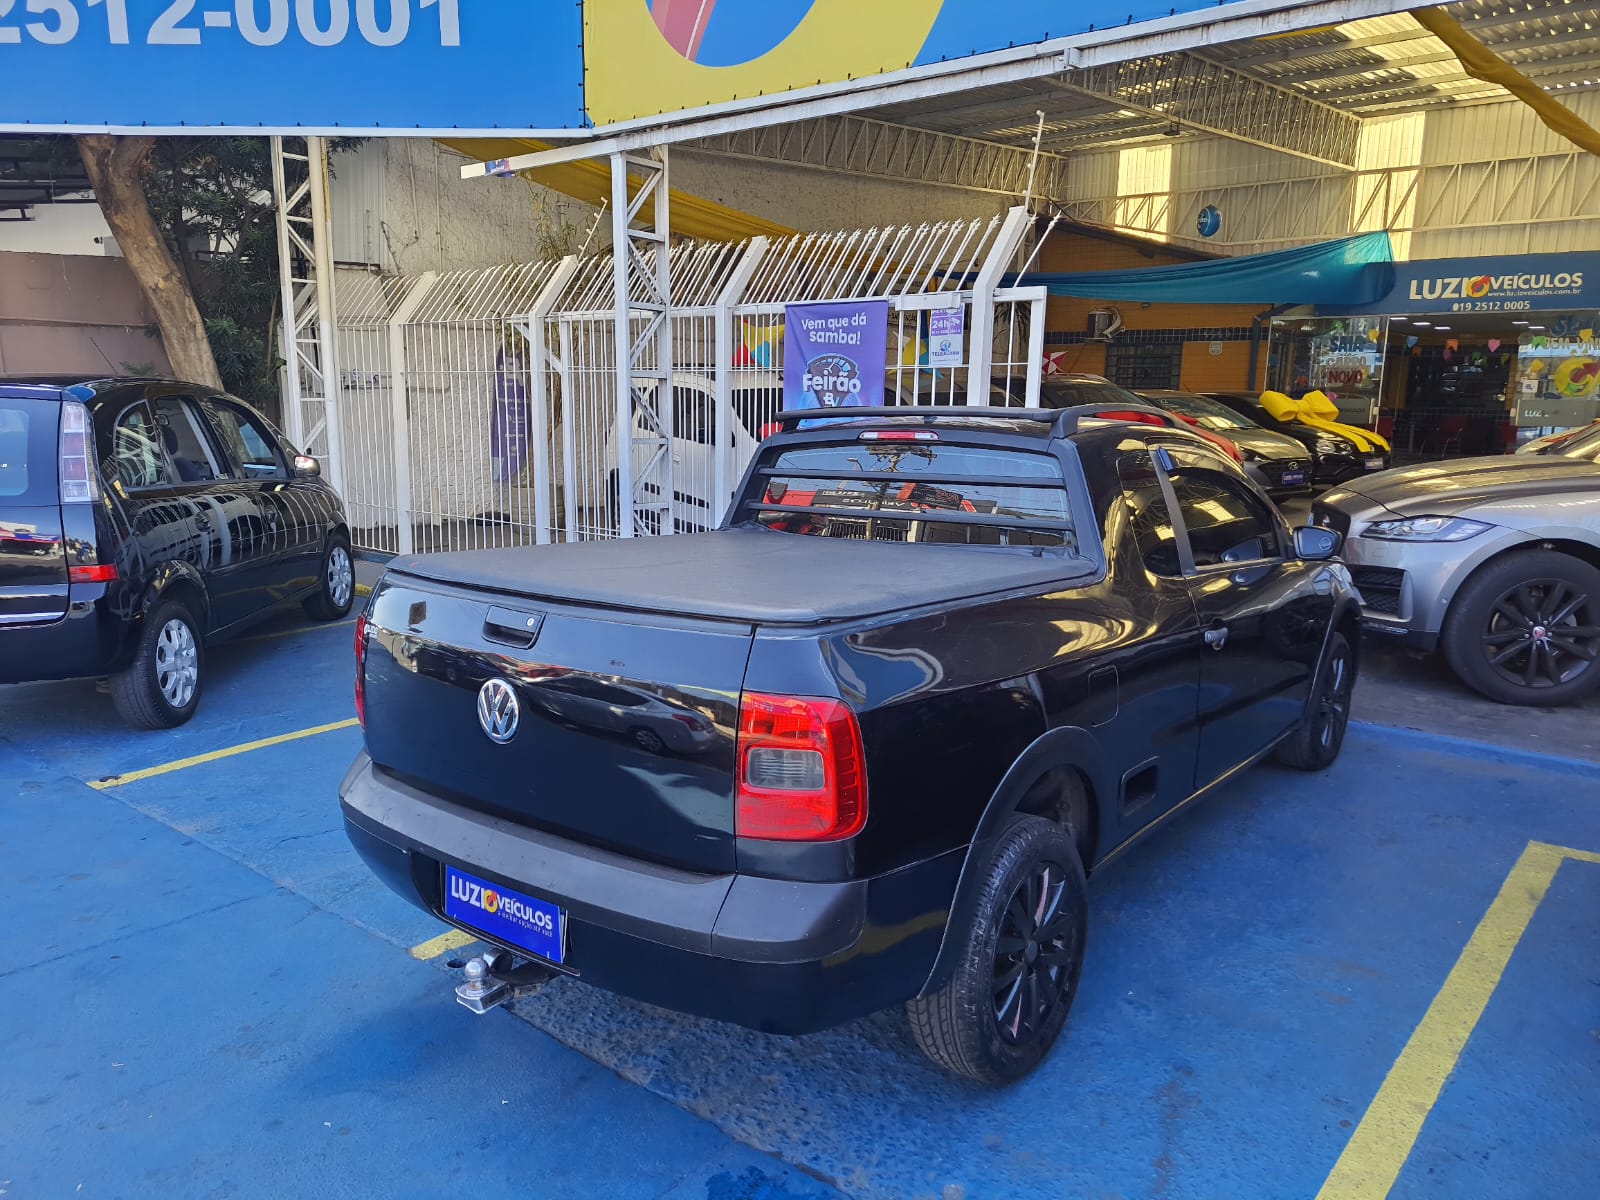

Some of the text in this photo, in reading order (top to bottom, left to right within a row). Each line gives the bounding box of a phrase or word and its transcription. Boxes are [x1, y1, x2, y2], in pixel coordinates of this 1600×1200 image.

[1452, 300, 1530, 312] 019 2512 0005
[801, 312, 867, 331] Vem que dá
[809, 328, 861, 345] samba!
[803, 370, 861, 393] Feirão
[497, 894, 553, 930] VEÍCULOS
